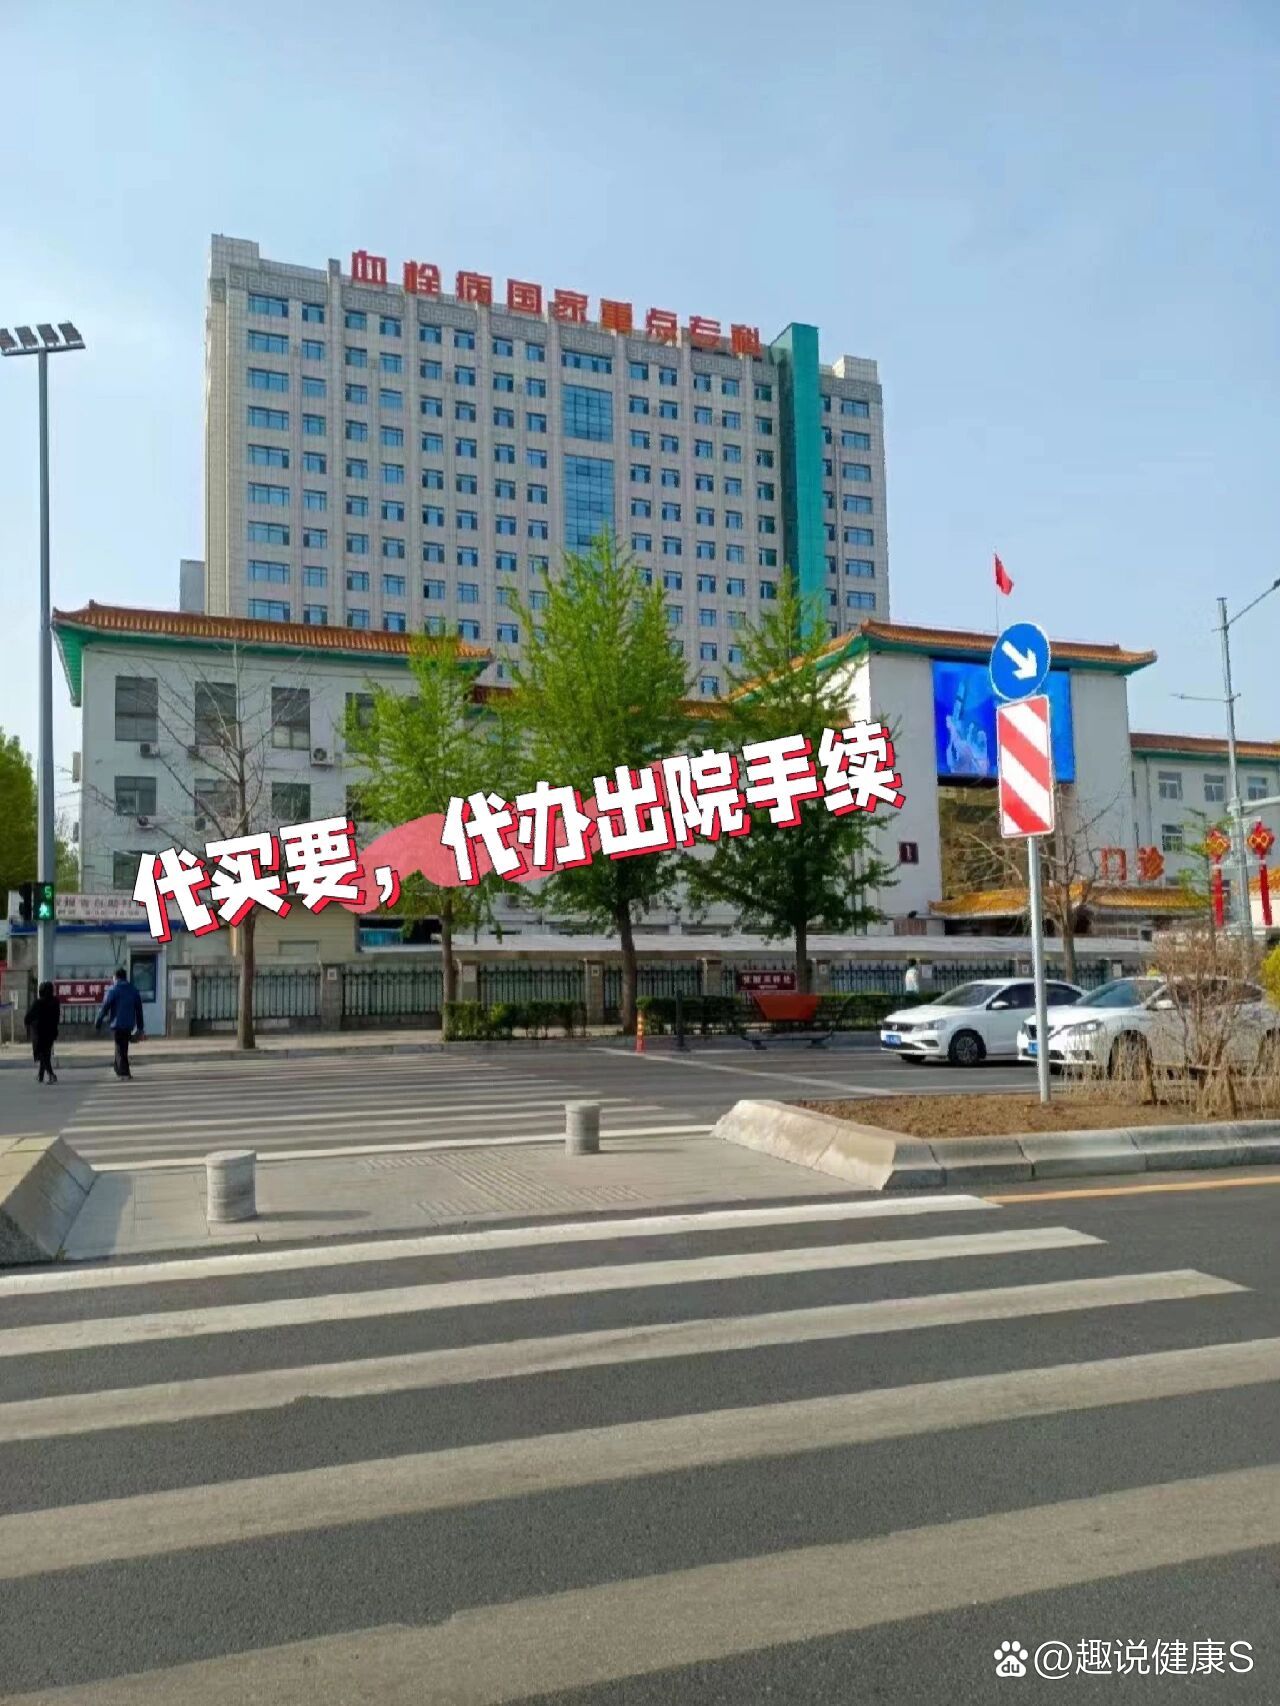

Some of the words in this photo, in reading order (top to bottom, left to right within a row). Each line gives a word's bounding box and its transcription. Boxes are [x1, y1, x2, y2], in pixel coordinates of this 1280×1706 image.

[352, 250, 760, 357] 血栓病国家重点专科
